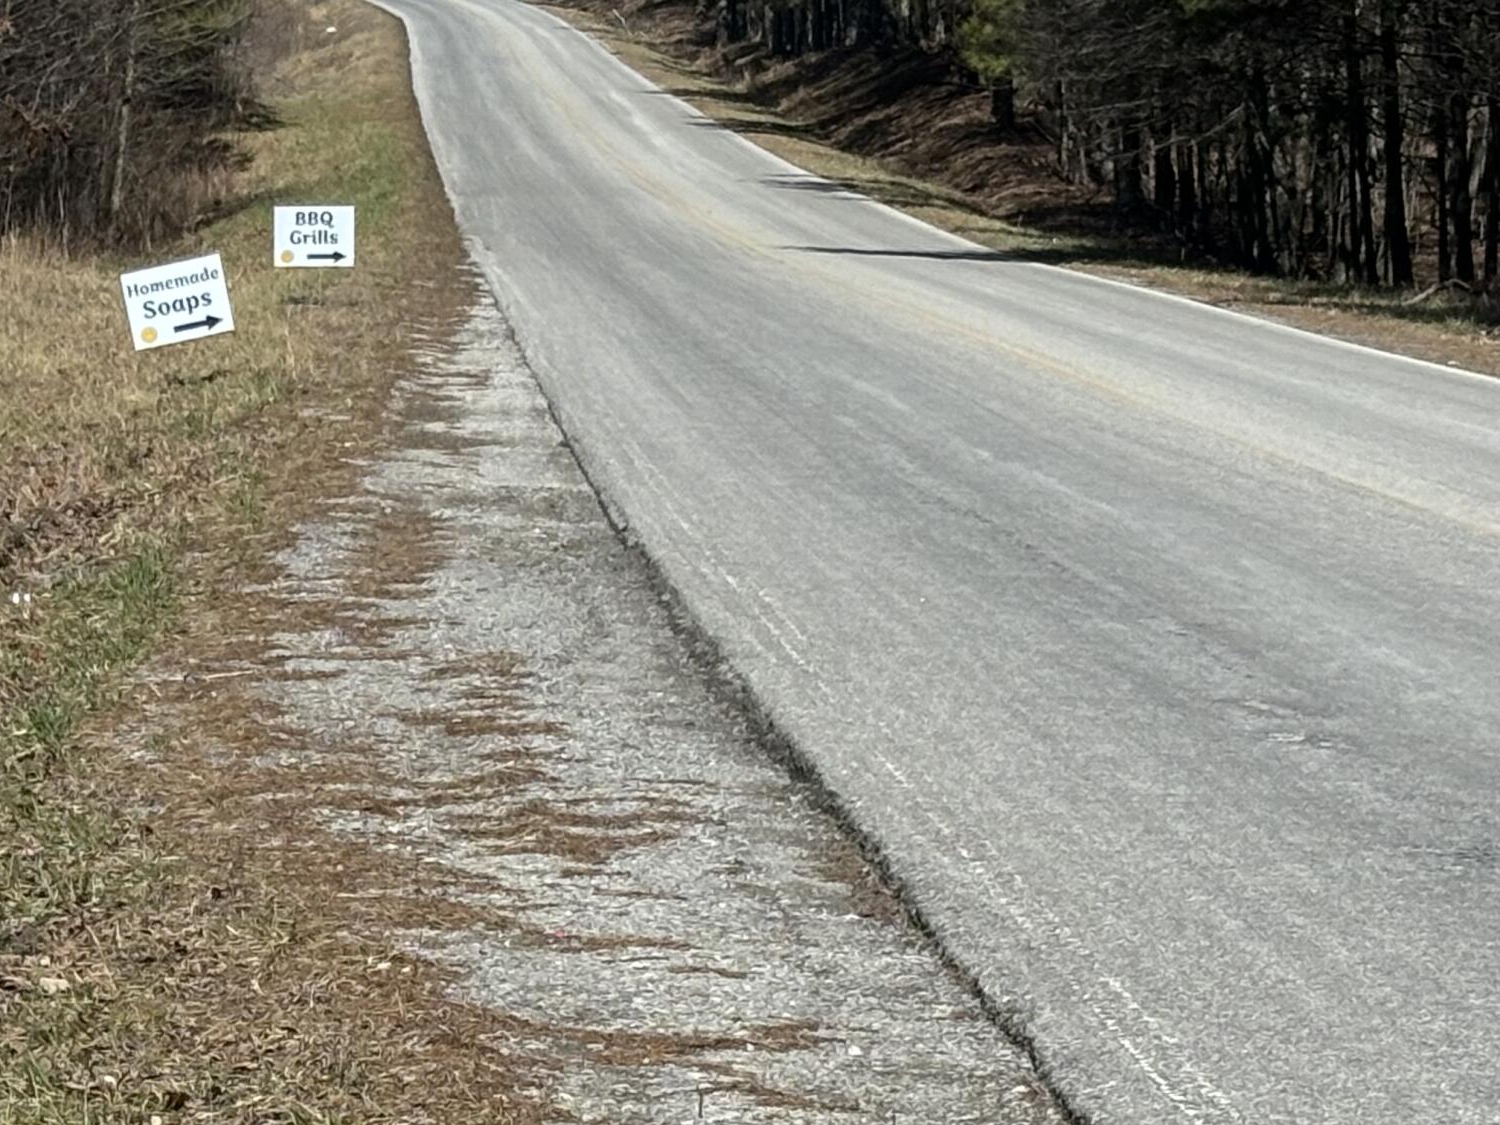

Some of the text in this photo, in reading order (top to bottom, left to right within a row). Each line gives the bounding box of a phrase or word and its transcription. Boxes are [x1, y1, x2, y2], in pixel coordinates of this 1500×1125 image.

[295, 211, 335, 229] BBQ
[289, 229, 339, 245] Grills
[126, 267, 219, 299] Homemade
[142, 291, 213, 320] Soaps
